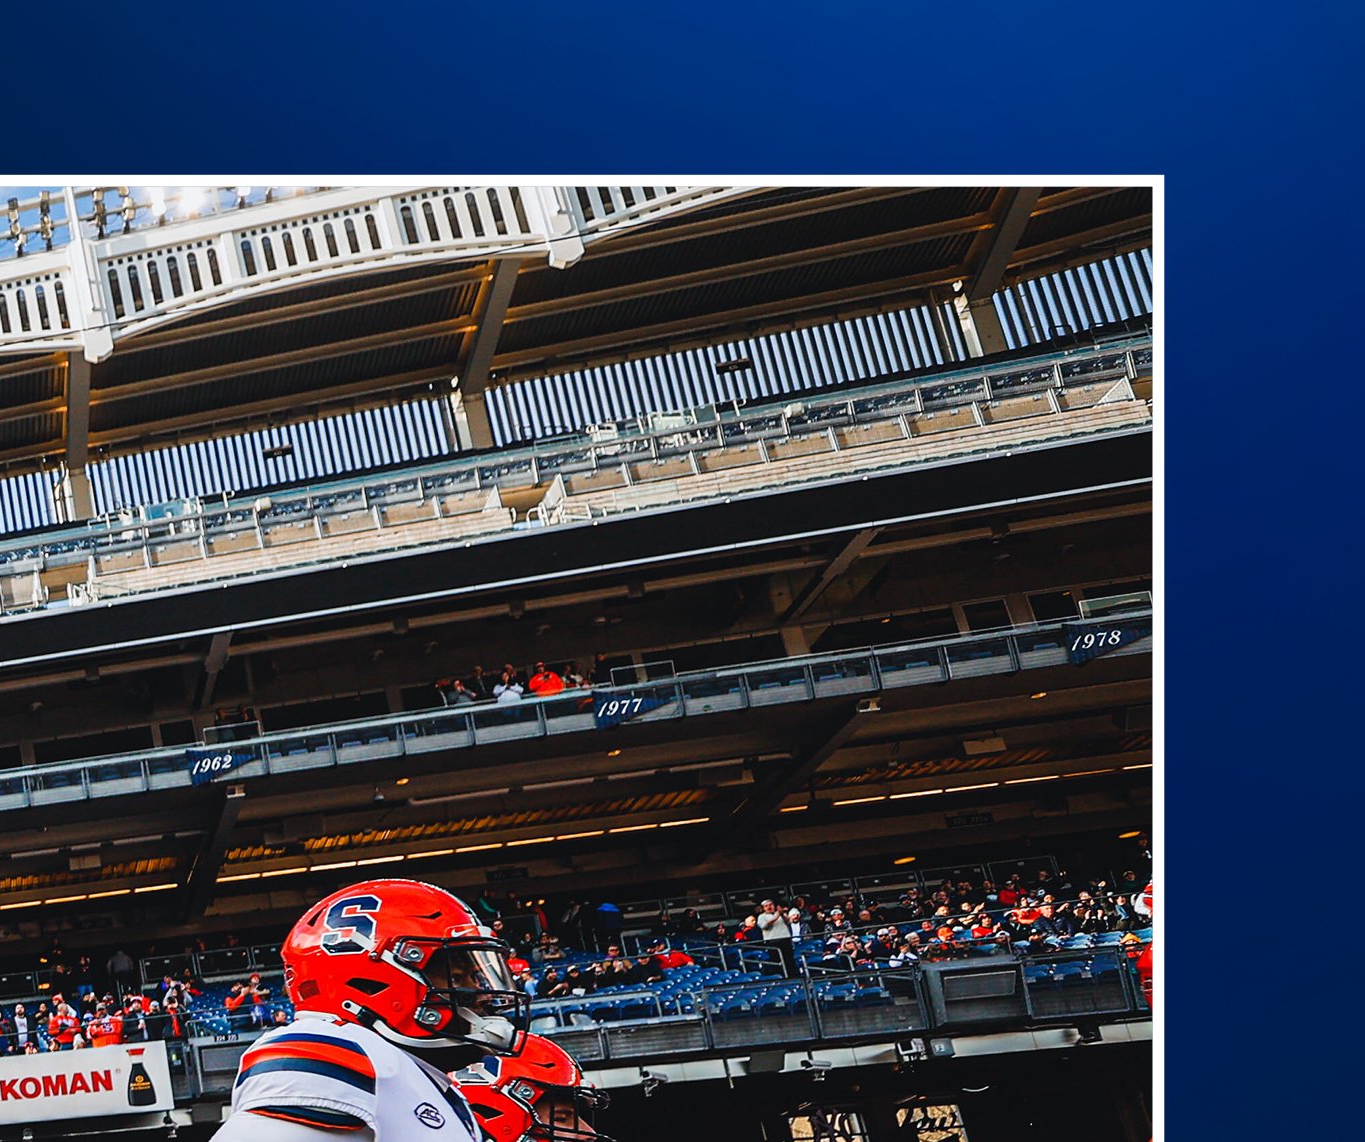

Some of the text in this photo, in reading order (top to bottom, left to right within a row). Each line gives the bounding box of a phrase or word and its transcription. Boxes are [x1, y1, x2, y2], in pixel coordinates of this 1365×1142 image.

[1071, 630, 1122, 652] 1978
[596, 698, 643, 717] 1977
[192, 754, 233, 774] 1962
[321, 894, 383, 956] S
